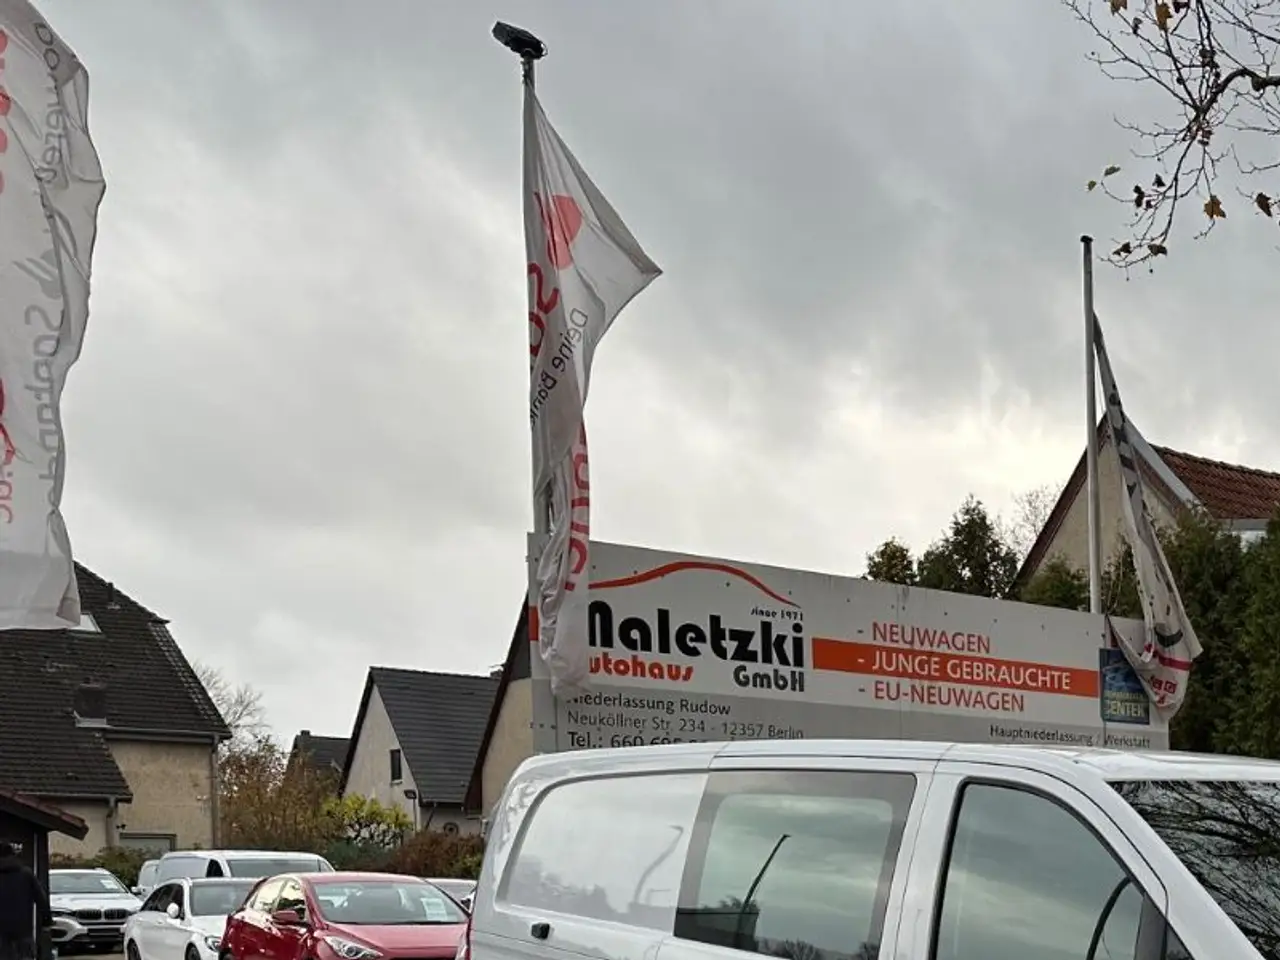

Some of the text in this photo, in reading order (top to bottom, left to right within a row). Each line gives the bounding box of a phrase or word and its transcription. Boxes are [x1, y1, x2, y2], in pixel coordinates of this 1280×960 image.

[750, 606, 804, 621] since 1971
[872, 621, 991, 654] NEUWAGEN
[589, 652, 694, 682] utohaus
[733, 665, 805, 692] GmbH
[872, 651, 1071, 690] JUNGE GEBRAUCHTE
[566, 691, 731, 715] iederlassung Rudow
[874, 680, 1025, 712] EU-NEUWAGEN
[567, 709, 647, 729] Neuköllner
[652, 716, 672, 731] Str.
[679, 717, 706, 733] 234
[722, 721, 763, 737] 12357
[768, 724, 804, 739] Berlin
[990, 724, 1094, 746] Hauptniederlassung
[1104, 734, 1150, 749] Werkstatt
[566, 731, 603, 748] Tel.:
